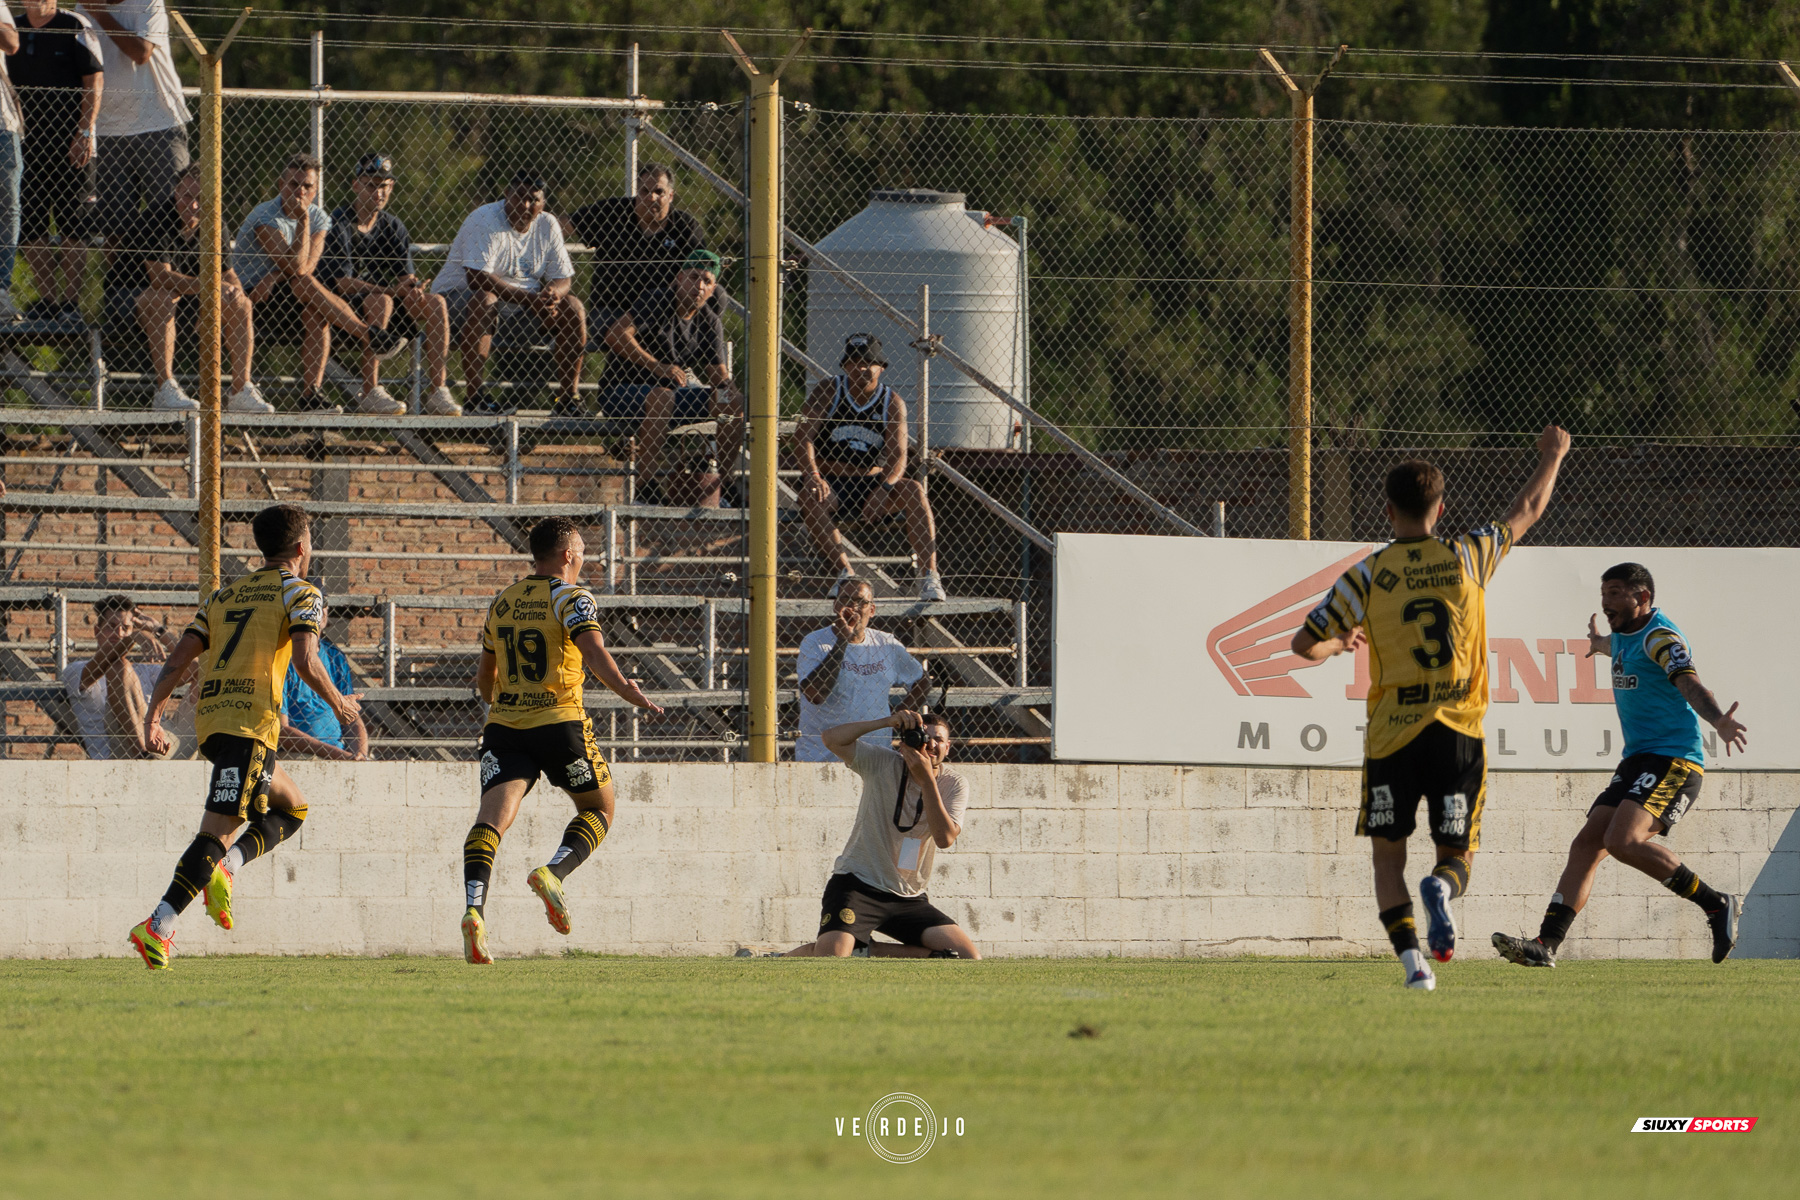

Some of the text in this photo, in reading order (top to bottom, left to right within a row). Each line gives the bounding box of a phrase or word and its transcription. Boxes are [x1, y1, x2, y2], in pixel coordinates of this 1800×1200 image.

[1403, 559, 1460, 577] Cerámica
[238, 583, 282, 593] Cerámica
[1406, 573, 1464, 590] Cortines
[234, 592, 277, 604] Cortines
[514, 598, 549, 610] Cerámica
[512, 609, 547, 621] Cortines
[213, 606, 258, 671] 7
[1402, 597, 1454, 671] 3
[496, 625, 550, 685] 19
[224, 678, 256, 687] PALLETS
[523, 691, 556, 700] PALLETS
[569, 769, 592, 787] 308
[1632, 771, 1657, 788] 20
[212, 788, 239, 803] 308
[1367, 809, 1395, 828] 308
[1439, 818, 1466, 837] 308
